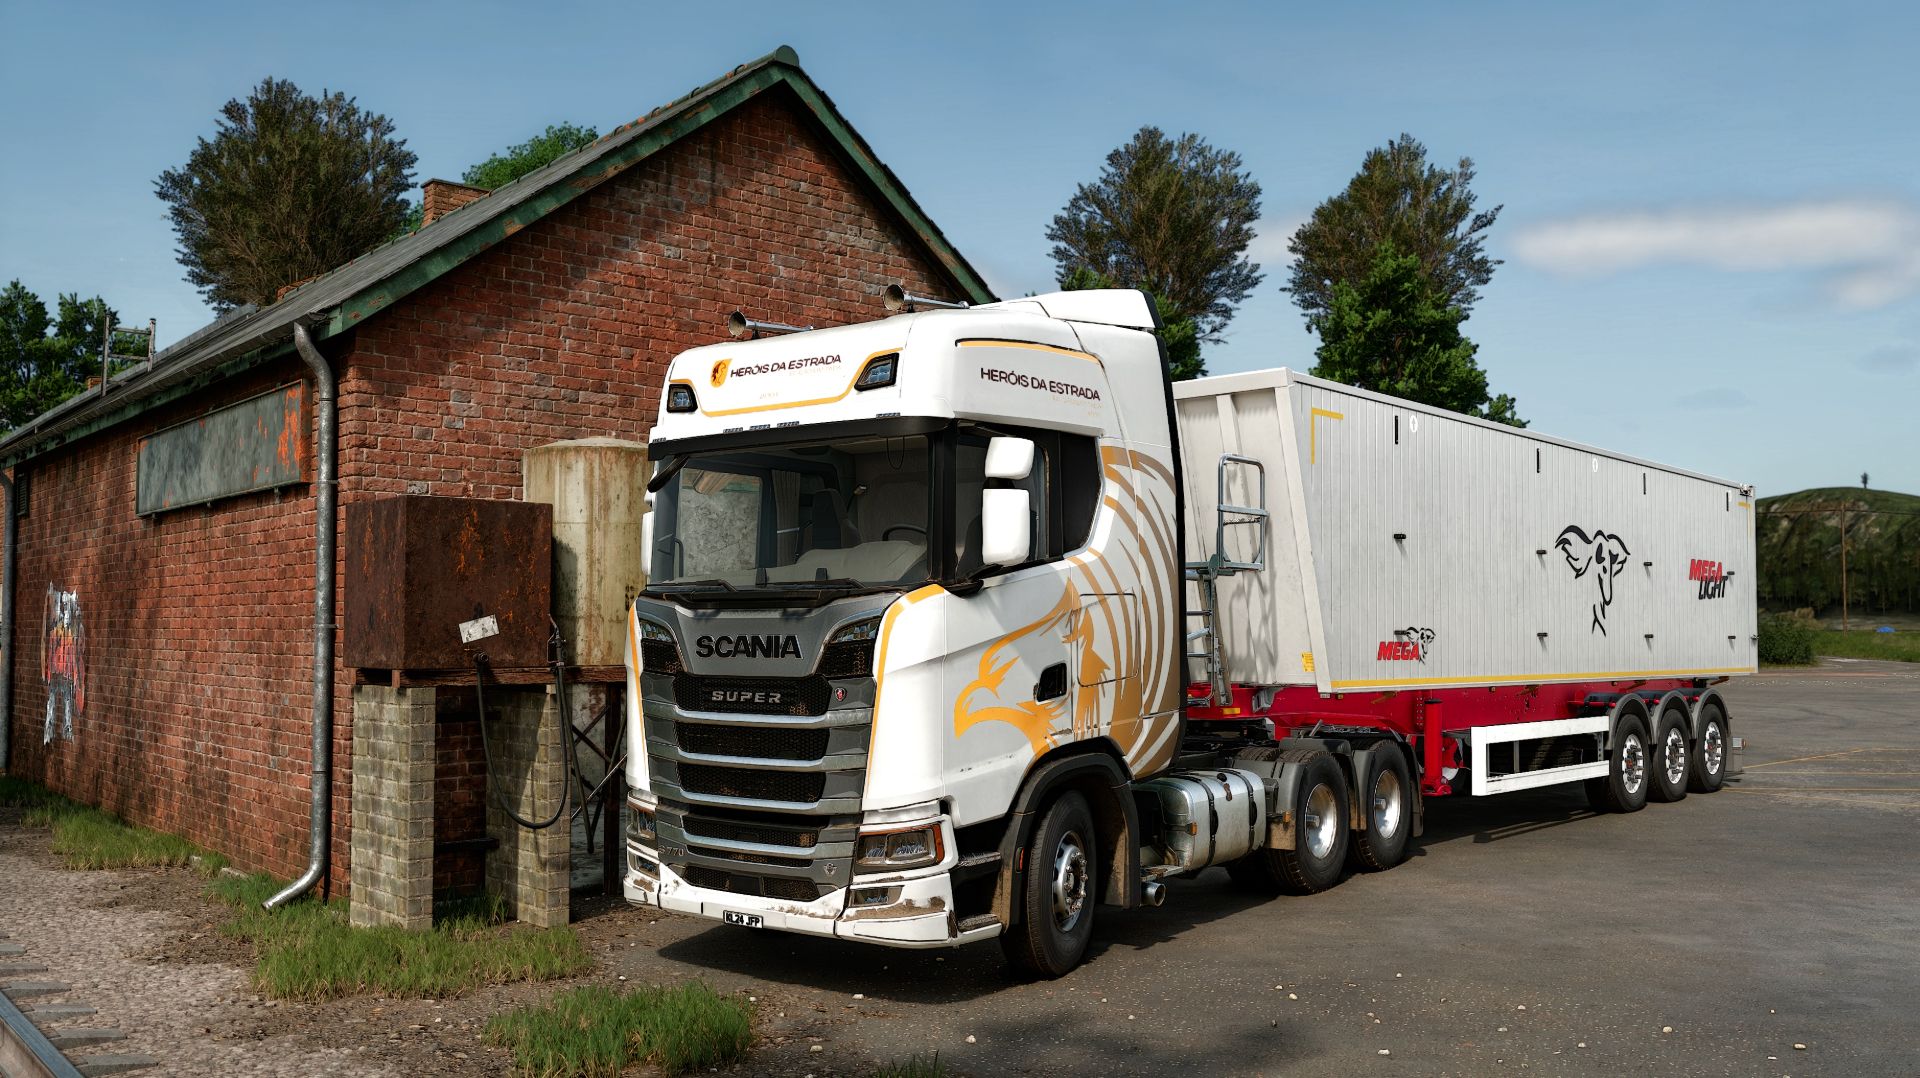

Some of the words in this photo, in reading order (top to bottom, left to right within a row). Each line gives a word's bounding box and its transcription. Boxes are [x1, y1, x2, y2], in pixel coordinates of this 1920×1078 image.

[730, 363, 770, 378] HERÓIS
[770, 361, 787, 373] DA
[787, 354, 842, 371] ESTRADA
[980, 367, 1029, 388] HERÓIS
[1031, 377, 1047, 391] DA
[1049, 381, 1101, 401] ESTRADA
[1688, 558, 1724, 583] MEGA
[1698, 575, 1729, 600] LIGHT
[696, 634, 804, 660] SCANIA
[1377, 641, 1420, 661] MEGA
[711, 690, 783, 704] SUPER
[745, 916, 761, 927] JFP
